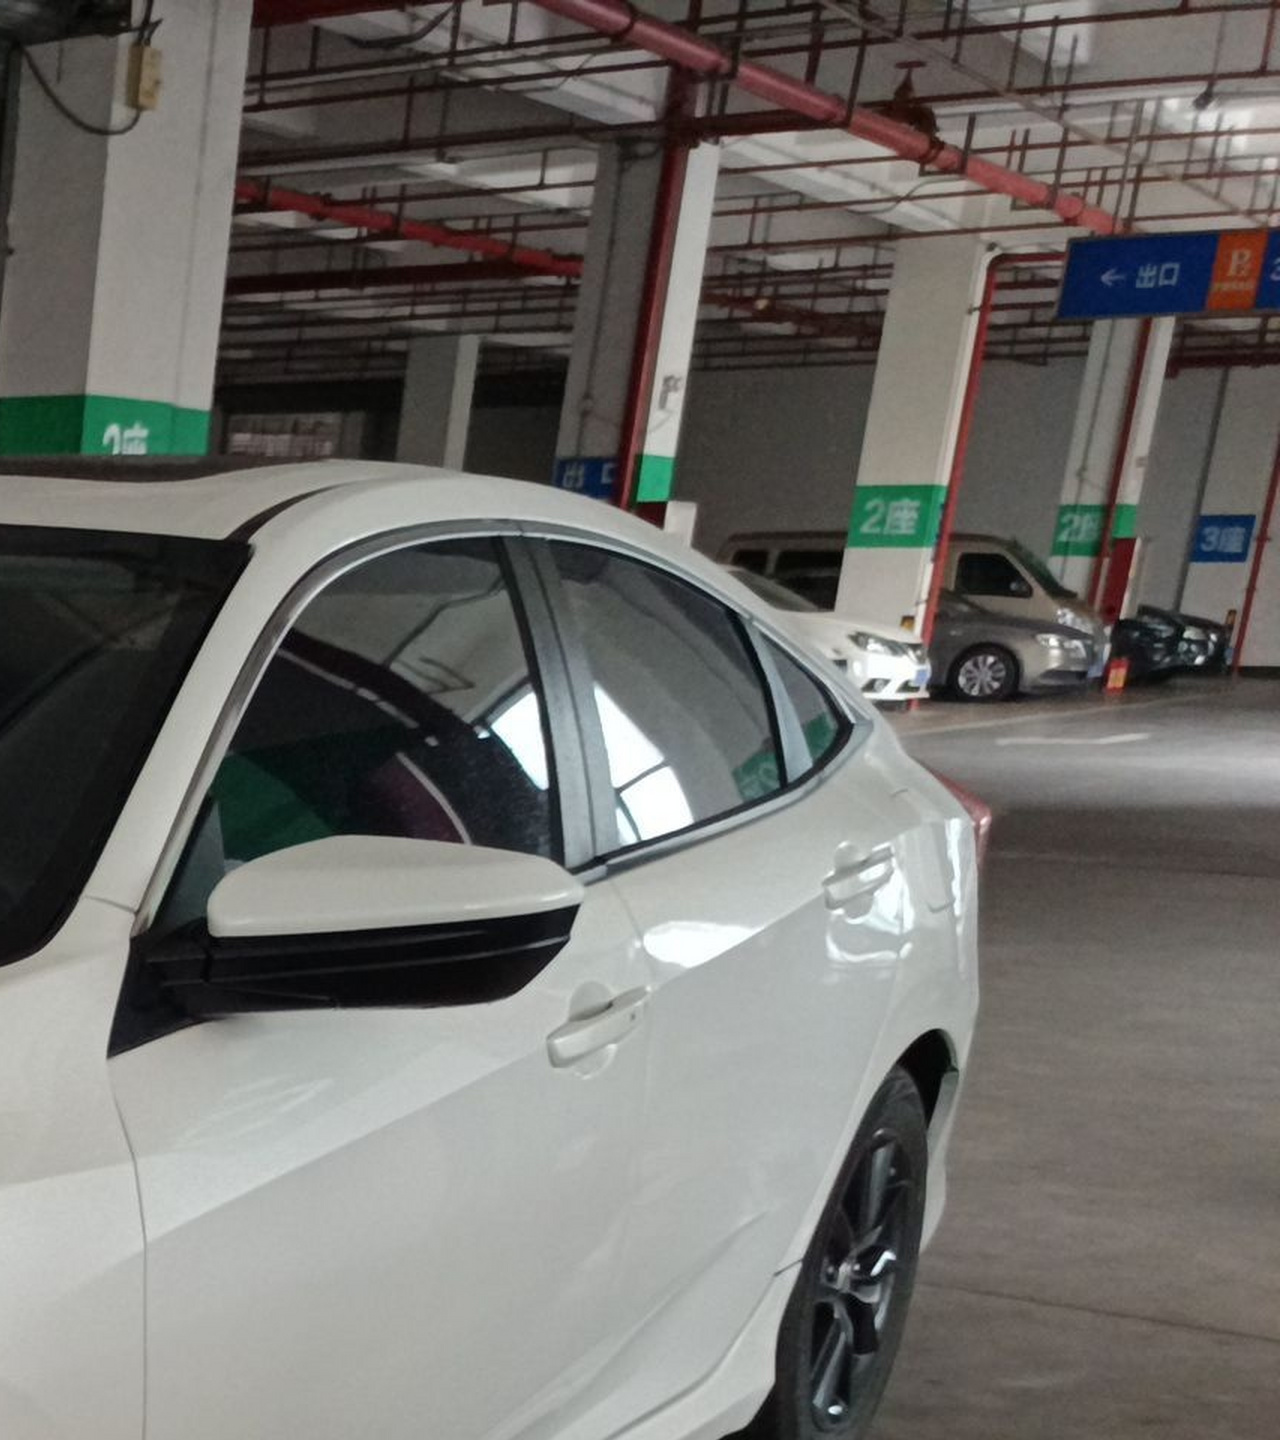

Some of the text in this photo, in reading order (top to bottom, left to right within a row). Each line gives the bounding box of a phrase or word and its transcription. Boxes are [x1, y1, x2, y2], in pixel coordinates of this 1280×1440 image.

[1136, 262, 1180, 288] 出口
[859, 496, 923, 536] 2座
[1199, 525, 1245, 554] 3座
